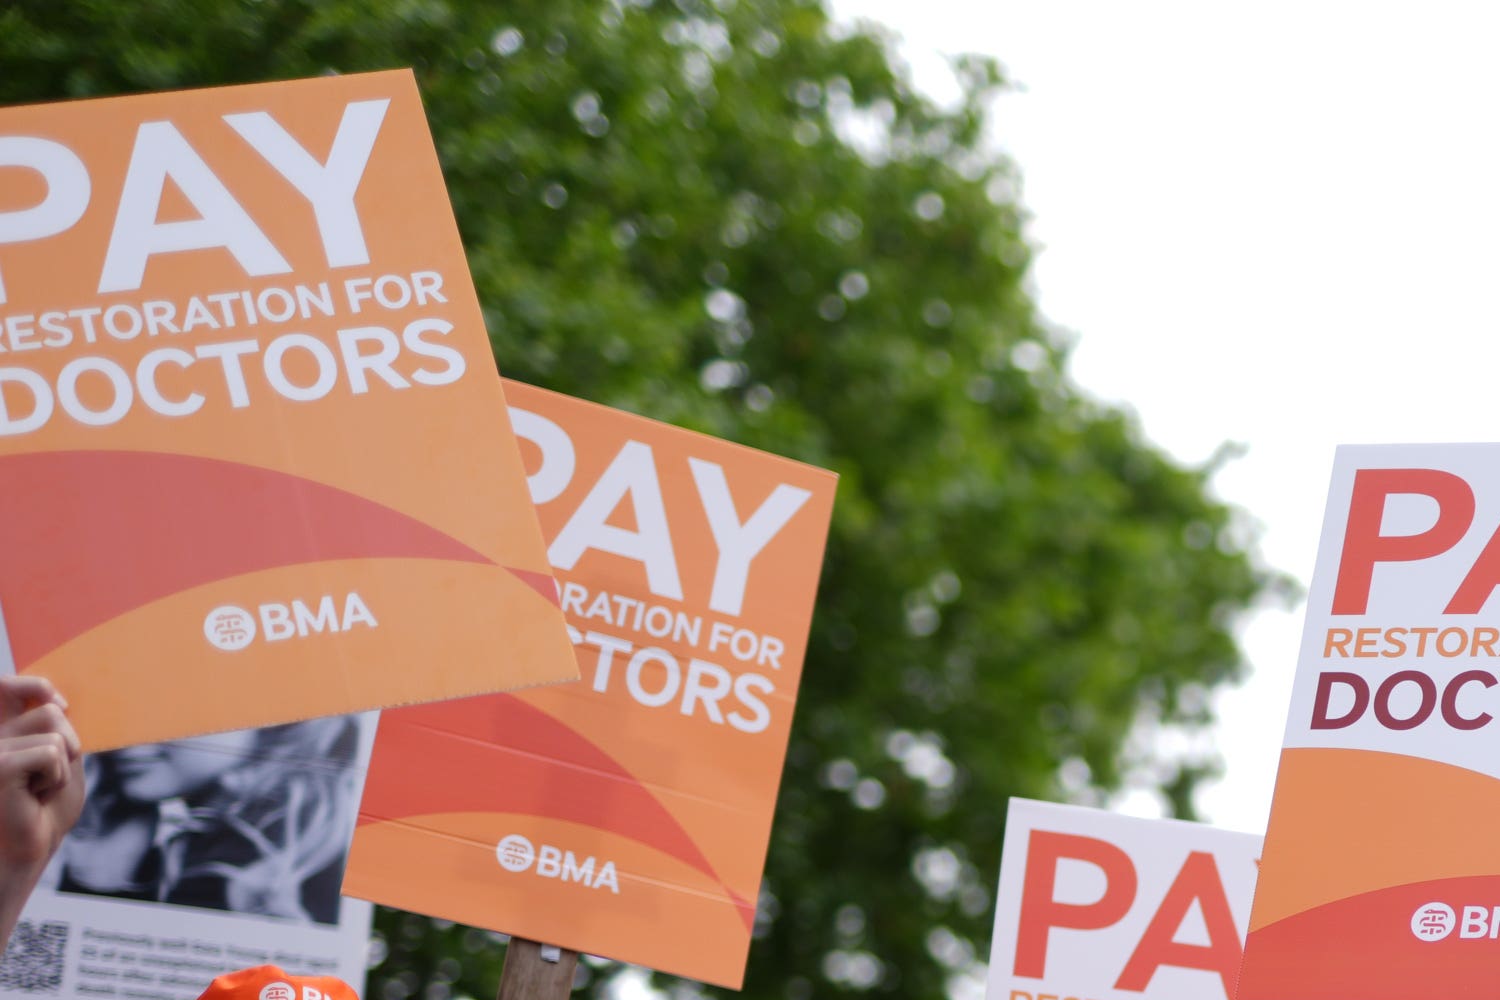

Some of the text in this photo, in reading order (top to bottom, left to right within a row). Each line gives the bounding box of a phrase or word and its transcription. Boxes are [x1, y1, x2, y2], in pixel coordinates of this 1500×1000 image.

[0, 271, 448, 352] ESTORATION FOR
[0, 318, 467, 437] DOCTORS
[264, 592, 378, 643] BMA
[708, 621, 785, 670] FOR
[568, 624, 775, 734] TORS
[536, 844, 620, 895] BMA
